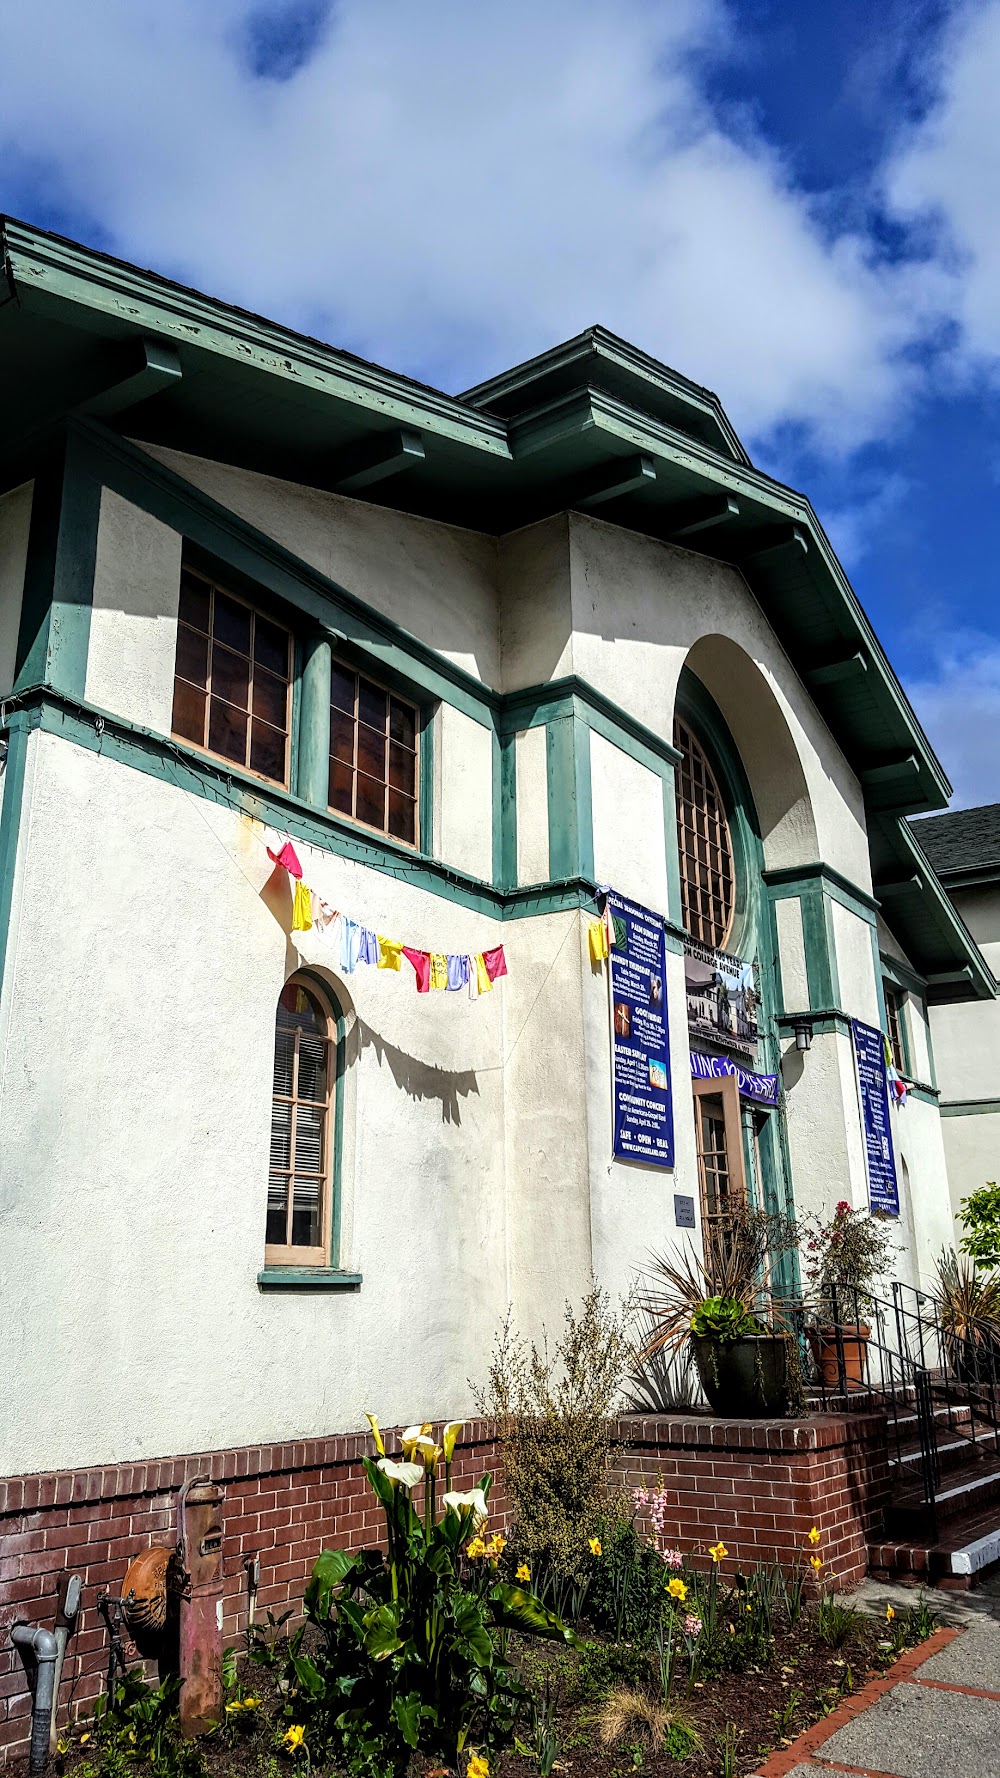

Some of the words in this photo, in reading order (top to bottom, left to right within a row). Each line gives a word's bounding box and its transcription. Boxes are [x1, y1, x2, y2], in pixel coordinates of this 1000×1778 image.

[693, 949, 718, 969] COLLEGE
[719, 961, 740, 979] AVENUE
[615, 1043, 631, 1056] EASTER
[620, 1129, 632, 1140] SAFE
[637, 1133, 651, 1145] OPEN
[656, 1138, 669, 1149] REAL
